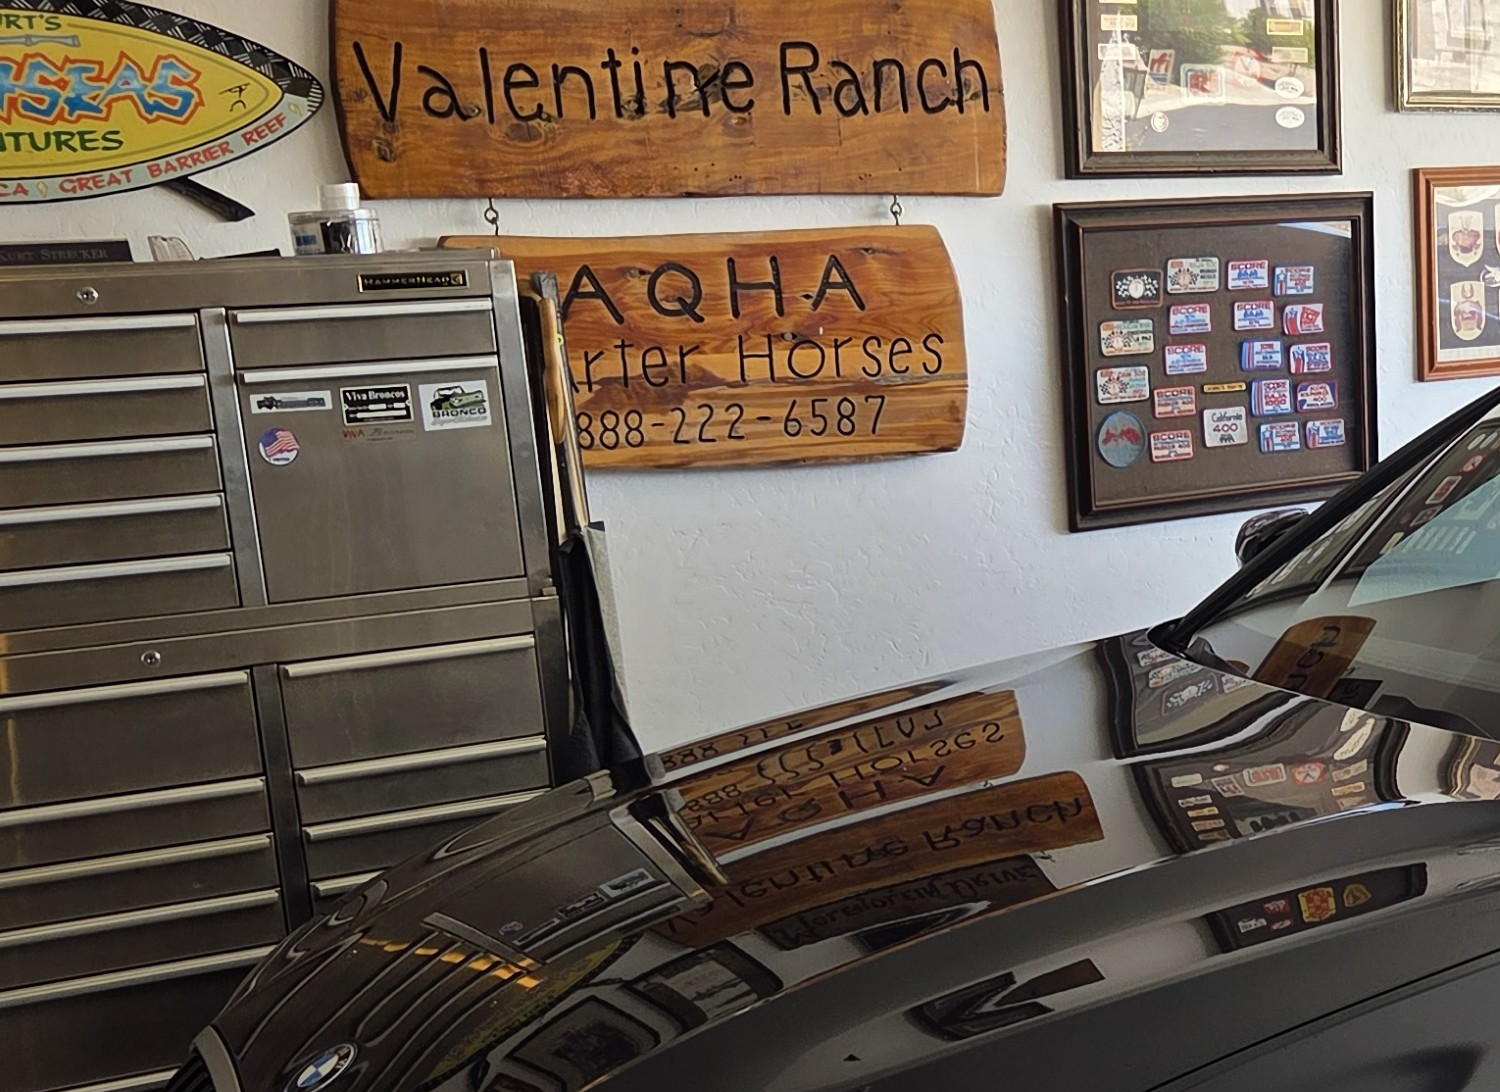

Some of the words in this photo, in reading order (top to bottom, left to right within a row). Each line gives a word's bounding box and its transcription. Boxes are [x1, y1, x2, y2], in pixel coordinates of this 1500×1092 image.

[353, 41, 754, 124] Valentine
[779, 41, 990, 117] Ranch
[59, 169, 132, 194] GREAT
[147, 141, 234, 178] BARRIER
[241, 112, 286, 146] REEF
[570, 338, 700, 393] rter
[738, 332, 944, 383] Horses
[432, 407, 487, 419] BRONCO
[1212, 422, 1239, 433] 400
